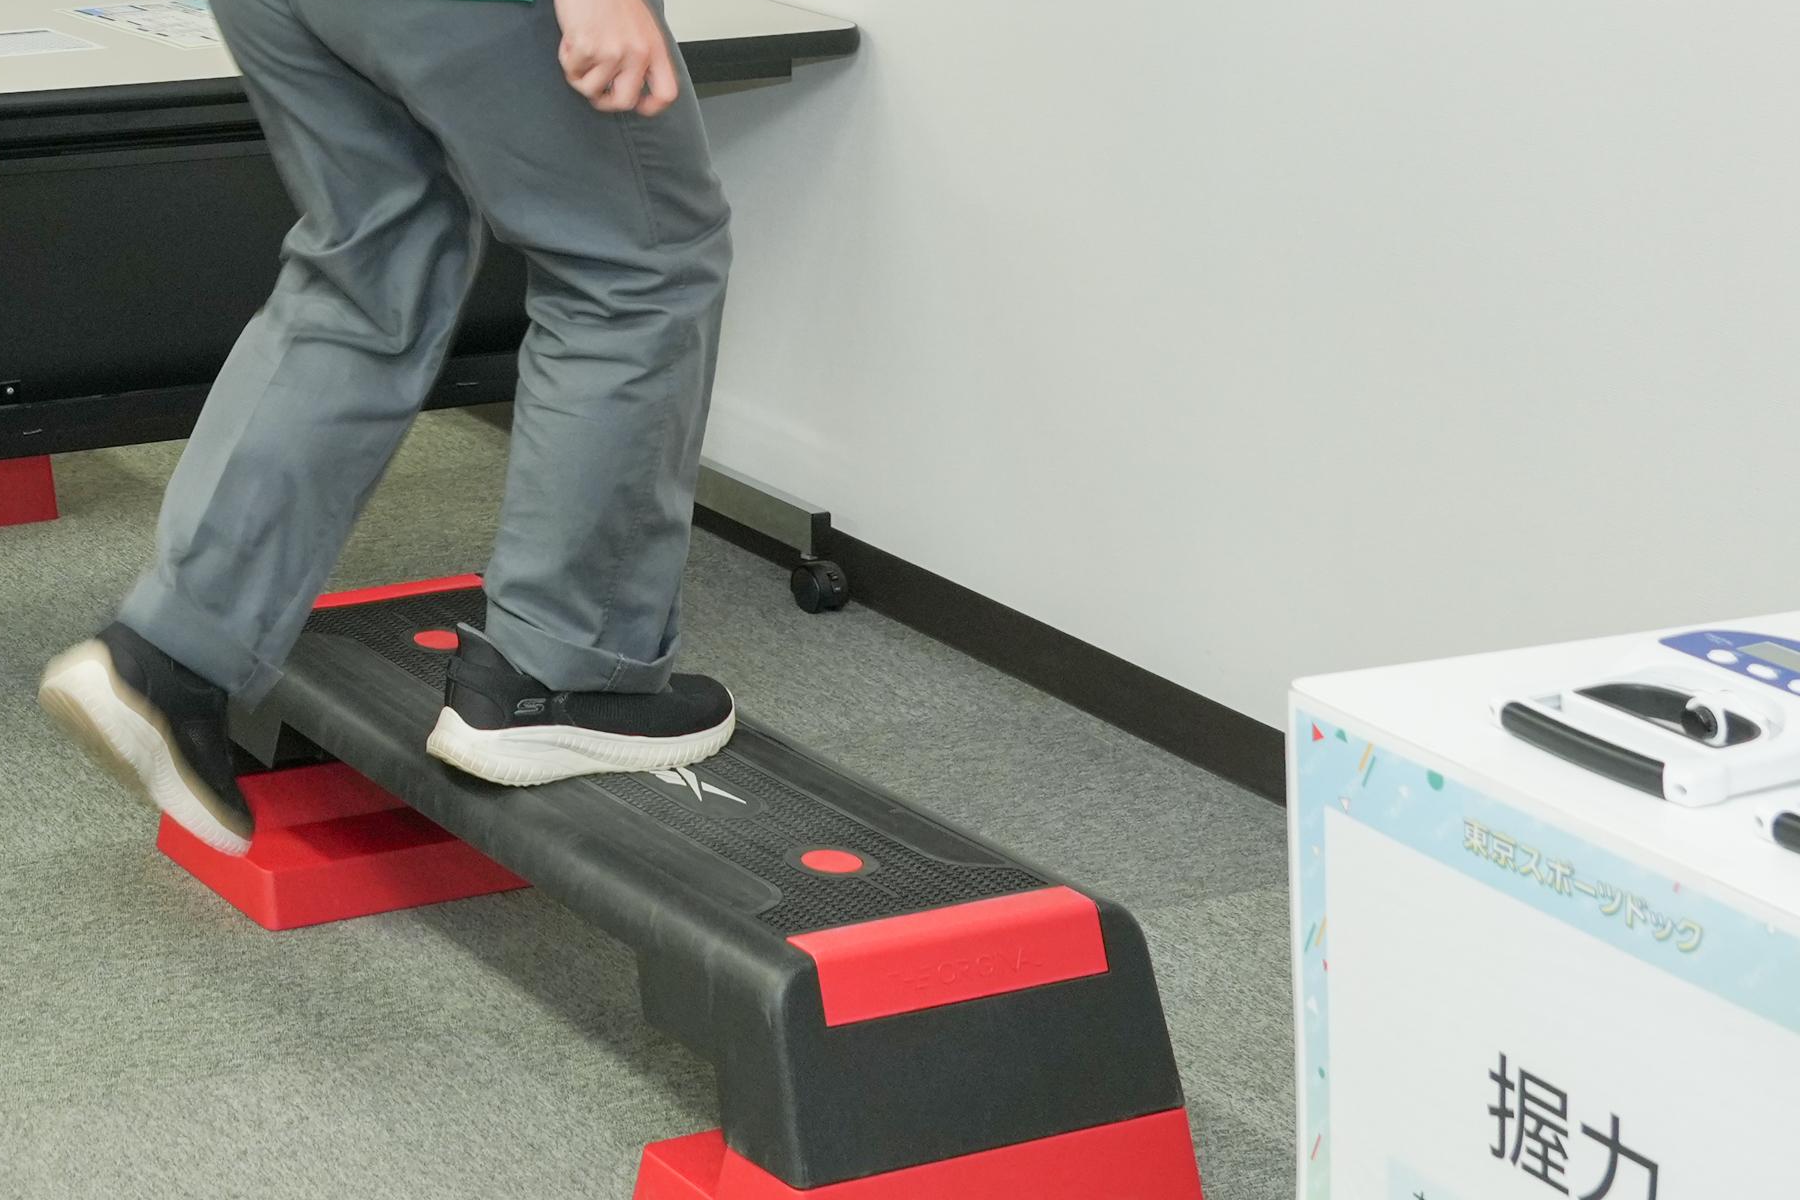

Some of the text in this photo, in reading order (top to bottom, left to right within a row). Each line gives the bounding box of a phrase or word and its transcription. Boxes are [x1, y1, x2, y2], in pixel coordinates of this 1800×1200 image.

[1463, 817, 1703, 953] 東京スポーツドック
[1487, 1050, 1659, 1200] 握力
